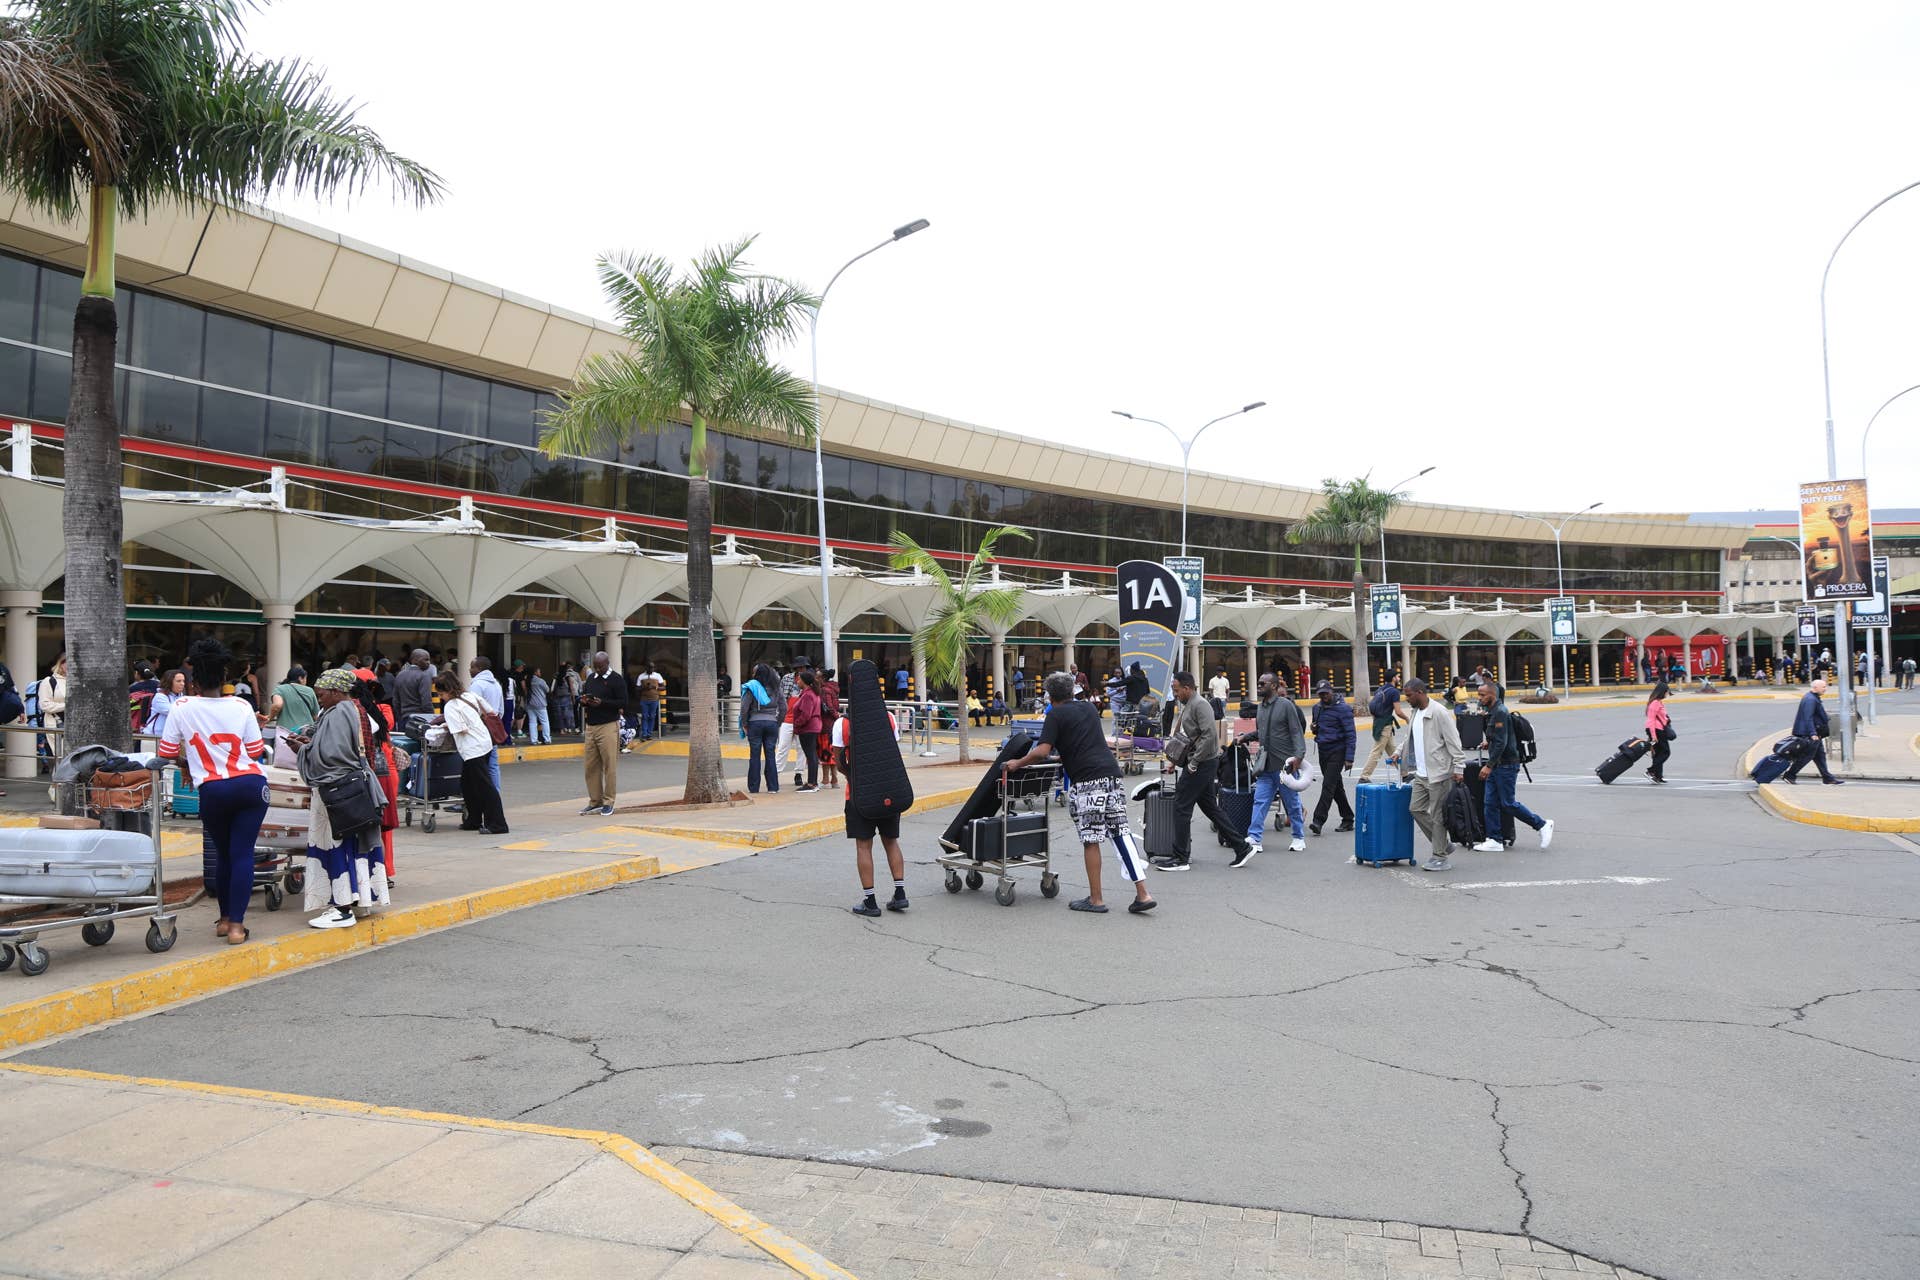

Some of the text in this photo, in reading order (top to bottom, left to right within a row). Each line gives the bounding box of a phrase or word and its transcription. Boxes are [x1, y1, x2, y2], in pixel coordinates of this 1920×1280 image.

[1815, 485, 1833, 493] YOU
[1835, 484, 1846, 492] AT
[1801, 494, 1843, 504] DUTY FREE
[1826, 583, 1867, 592] PROCERA
[1125, 577, 1173, 610] 1A
[1852, 614, 1889, 622] PROCERA
[529, 622, 555, 630] Departures
[189, 732, 262, 782] 12
